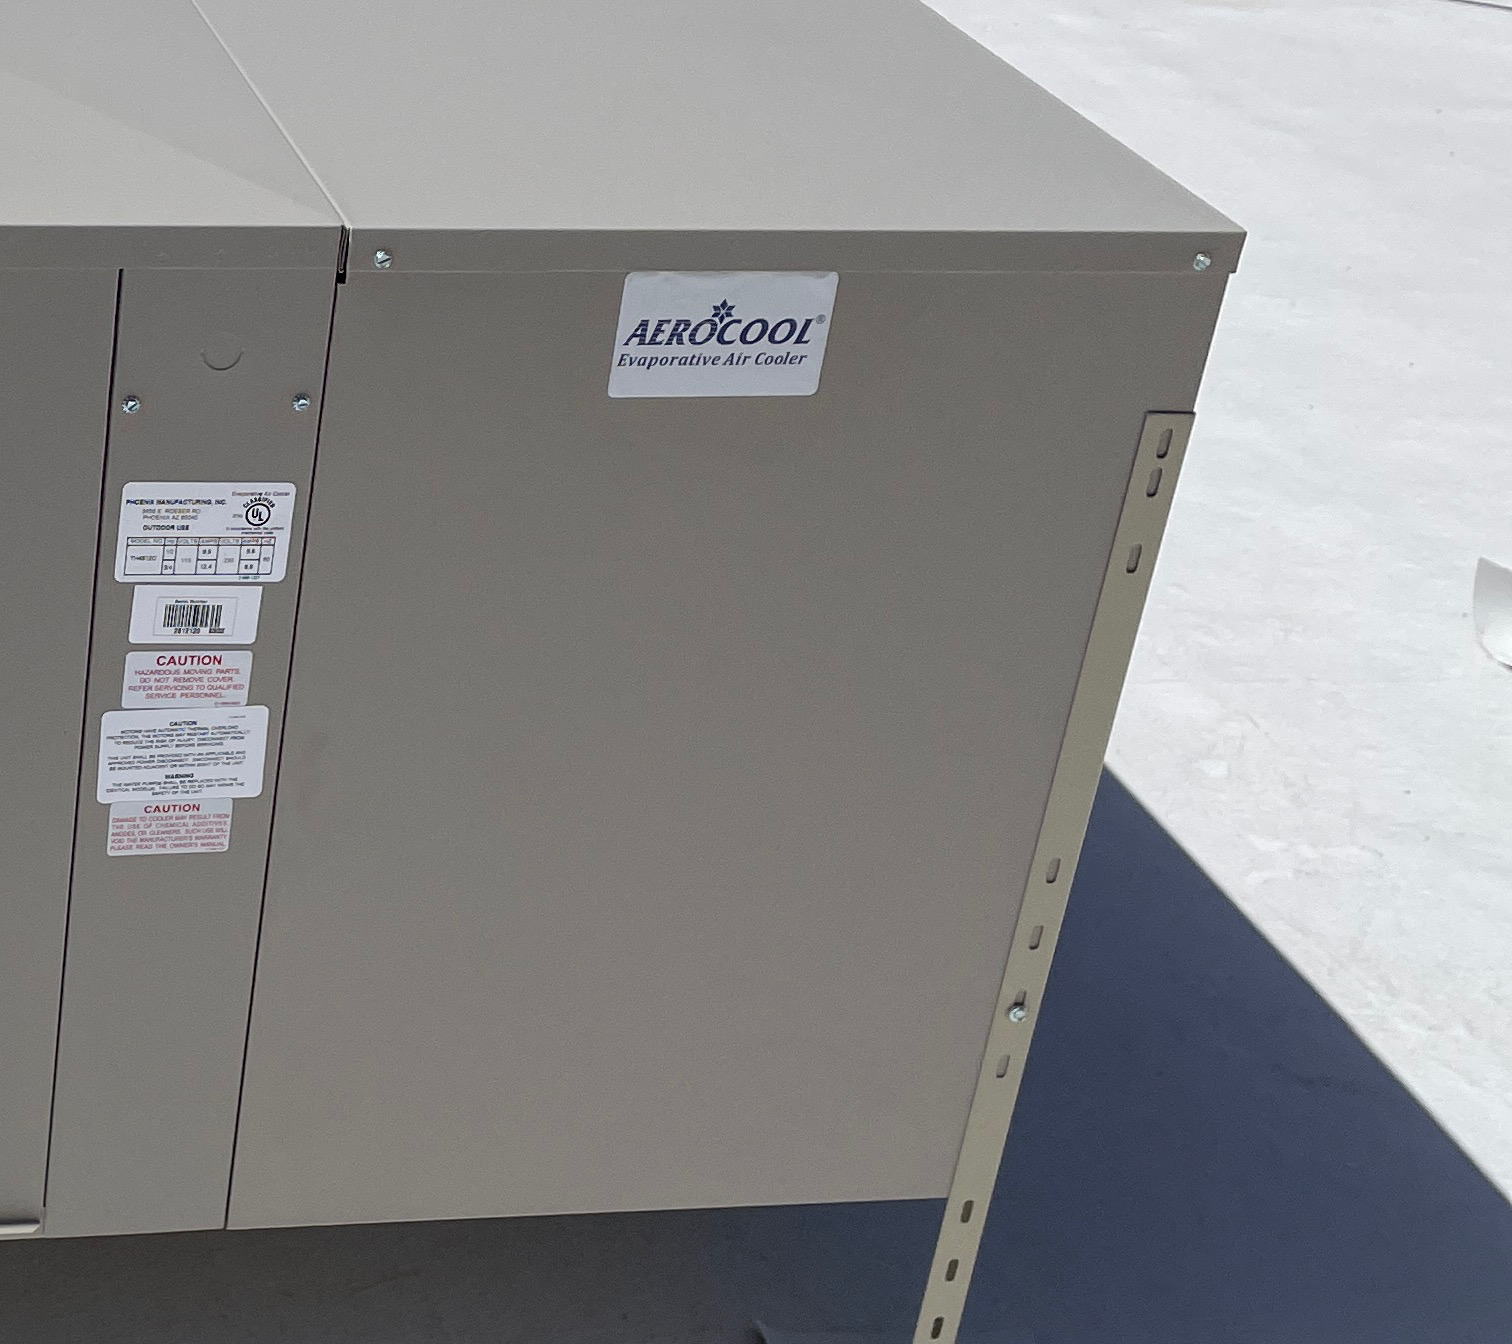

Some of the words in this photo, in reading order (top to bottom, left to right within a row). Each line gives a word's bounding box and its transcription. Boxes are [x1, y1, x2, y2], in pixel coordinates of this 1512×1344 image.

[617, 352, 720, 370] Evaporative
[722, 352, 751, 366] Air
[755, 352, 808, 366] Cooler
[156, 655, 222, 666] CAUTION
[144, 803, 201, 814] CAUTION
